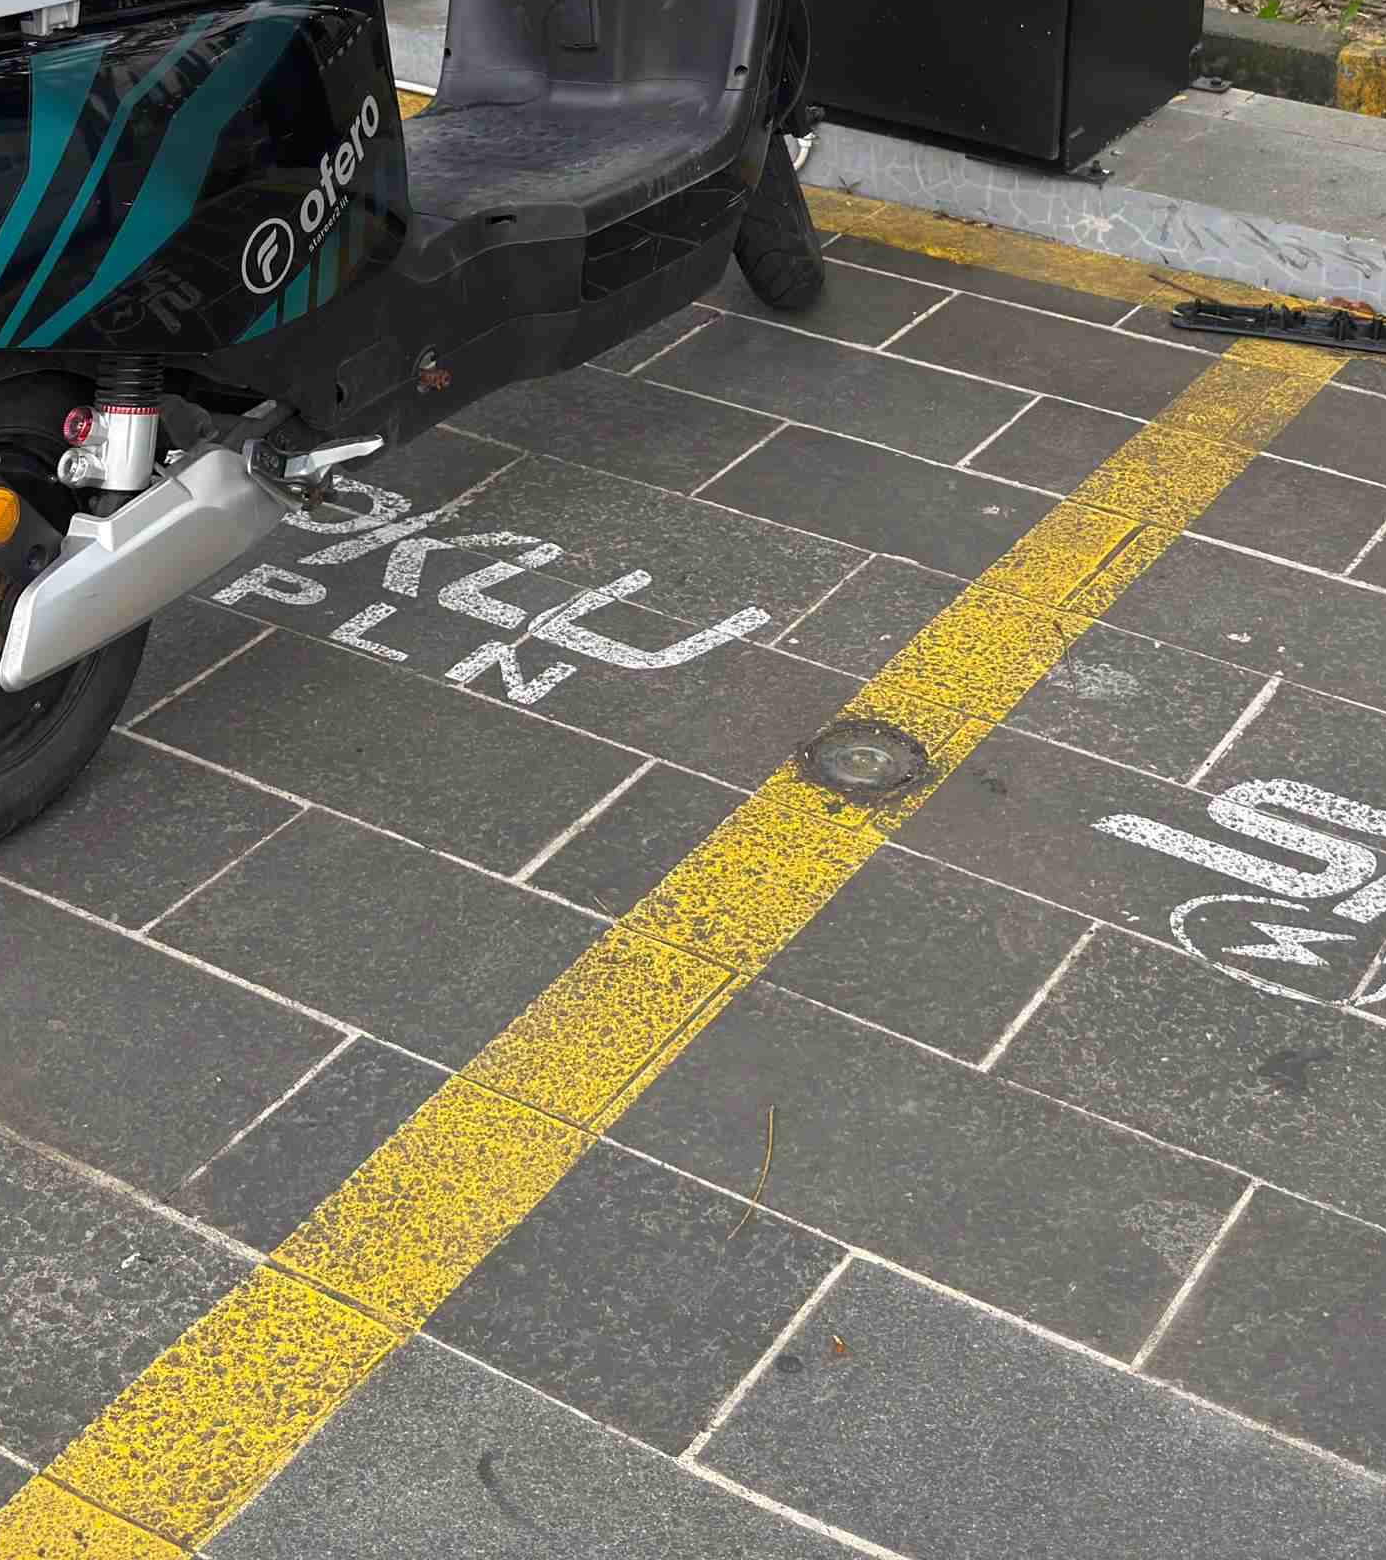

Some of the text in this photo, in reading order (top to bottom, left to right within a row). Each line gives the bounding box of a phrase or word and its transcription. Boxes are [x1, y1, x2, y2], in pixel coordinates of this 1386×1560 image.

[299, 95, 380, 233] ofero
[212, 562, 578, 705] PLN
[281, 474, 771, 669] PKLU
